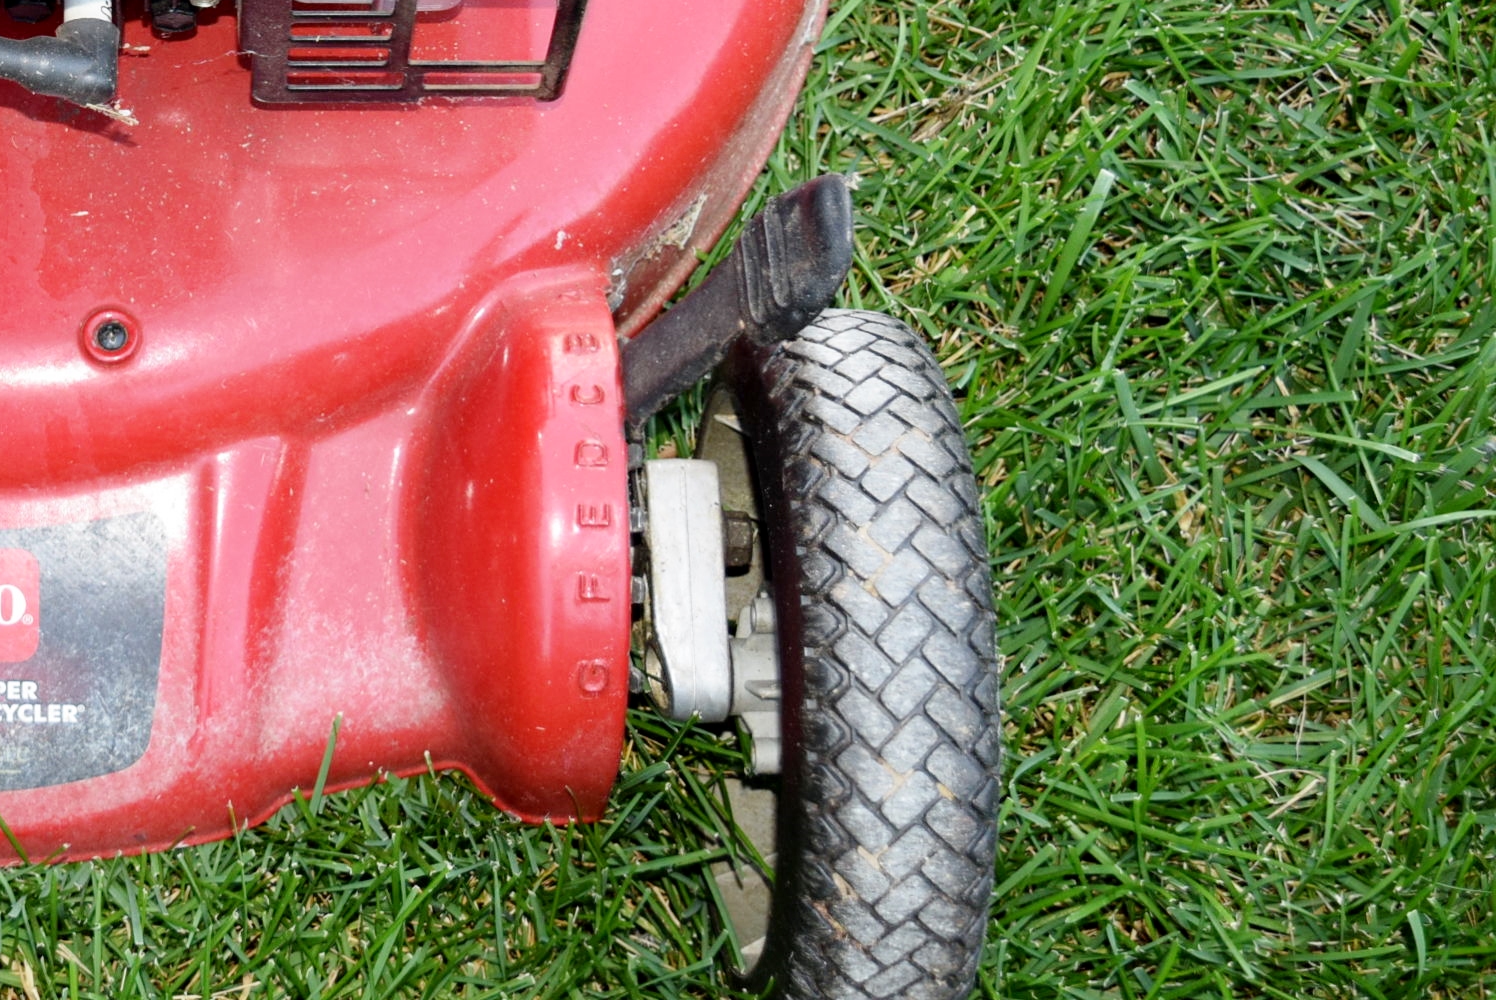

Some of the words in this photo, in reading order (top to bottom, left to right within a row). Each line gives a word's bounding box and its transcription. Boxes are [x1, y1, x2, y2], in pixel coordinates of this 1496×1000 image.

[573, 439, 608, 468] D
[577, 503, 612, 528] E
[578, 571, 611, 602] F
